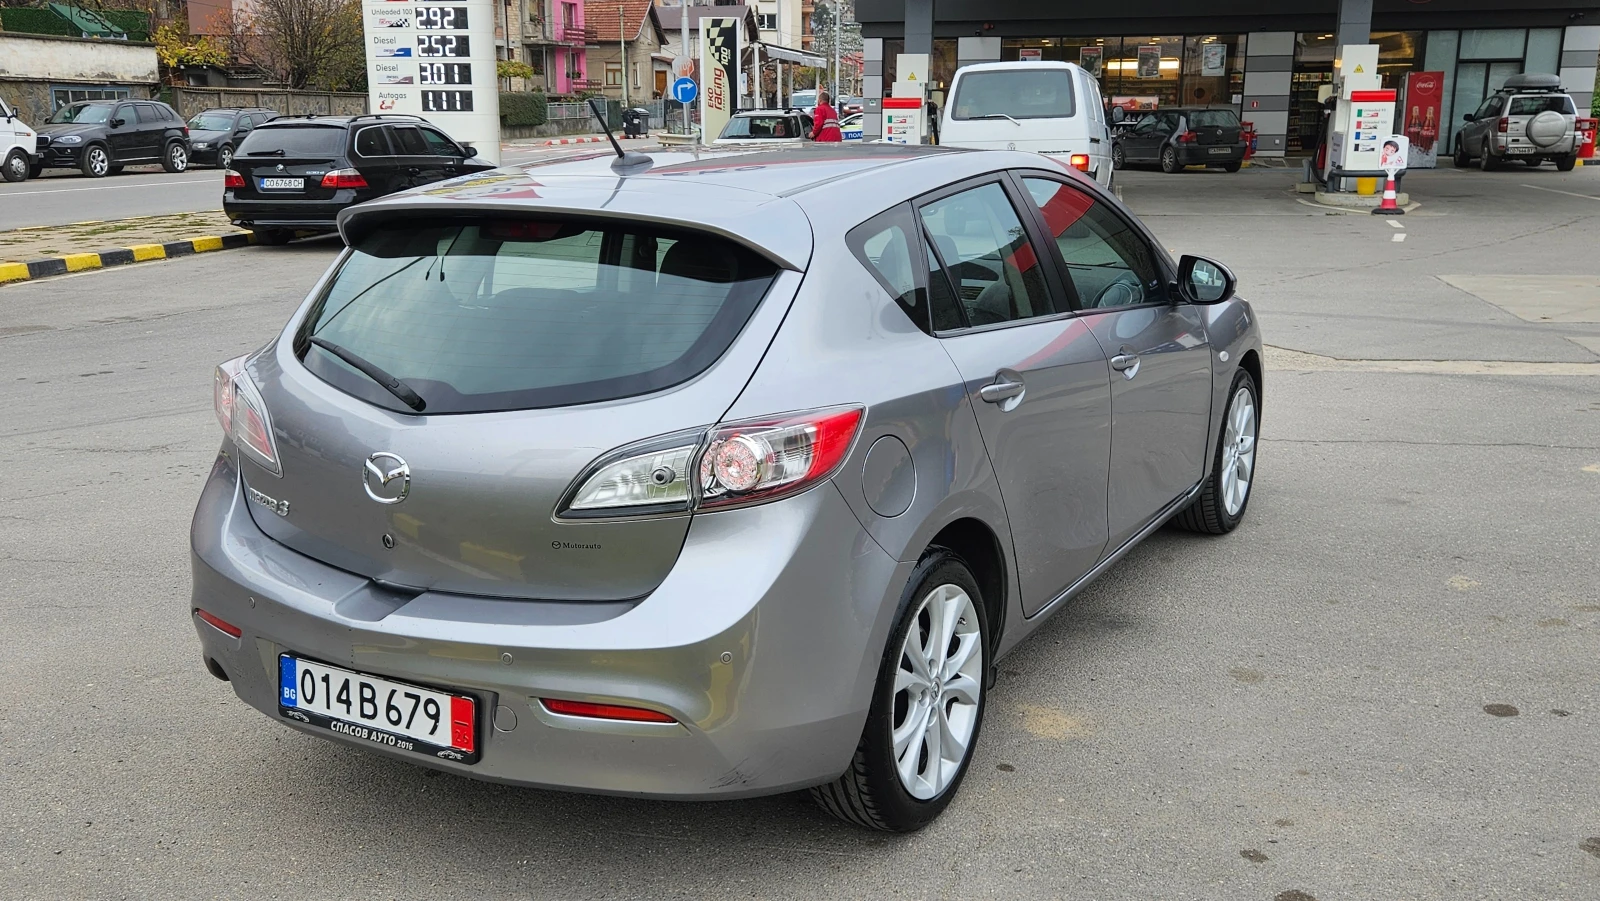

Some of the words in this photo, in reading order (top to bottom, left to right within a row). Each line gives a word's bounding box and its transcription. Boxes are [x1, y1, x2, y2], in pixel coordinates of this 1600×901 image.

[416, 8, 455, 29] 2.92
[418, 36, 457, 56] 2.52
[721, 46, 729, 66] 100
[421, 63, 459, 84] 3.01
[378, 92, 407, 100] Autogas
[714, 67, 725, 110] racing
[428, 91, 461, 111] 1.11
[283, 686, 296, 700] BG
[300, 668, 441, 736] 014B679
[330, 721, 369, 739] СПАСОВ
[370, 731, 396, 747] АУТО
[396, 739, 413, 751] 2016
